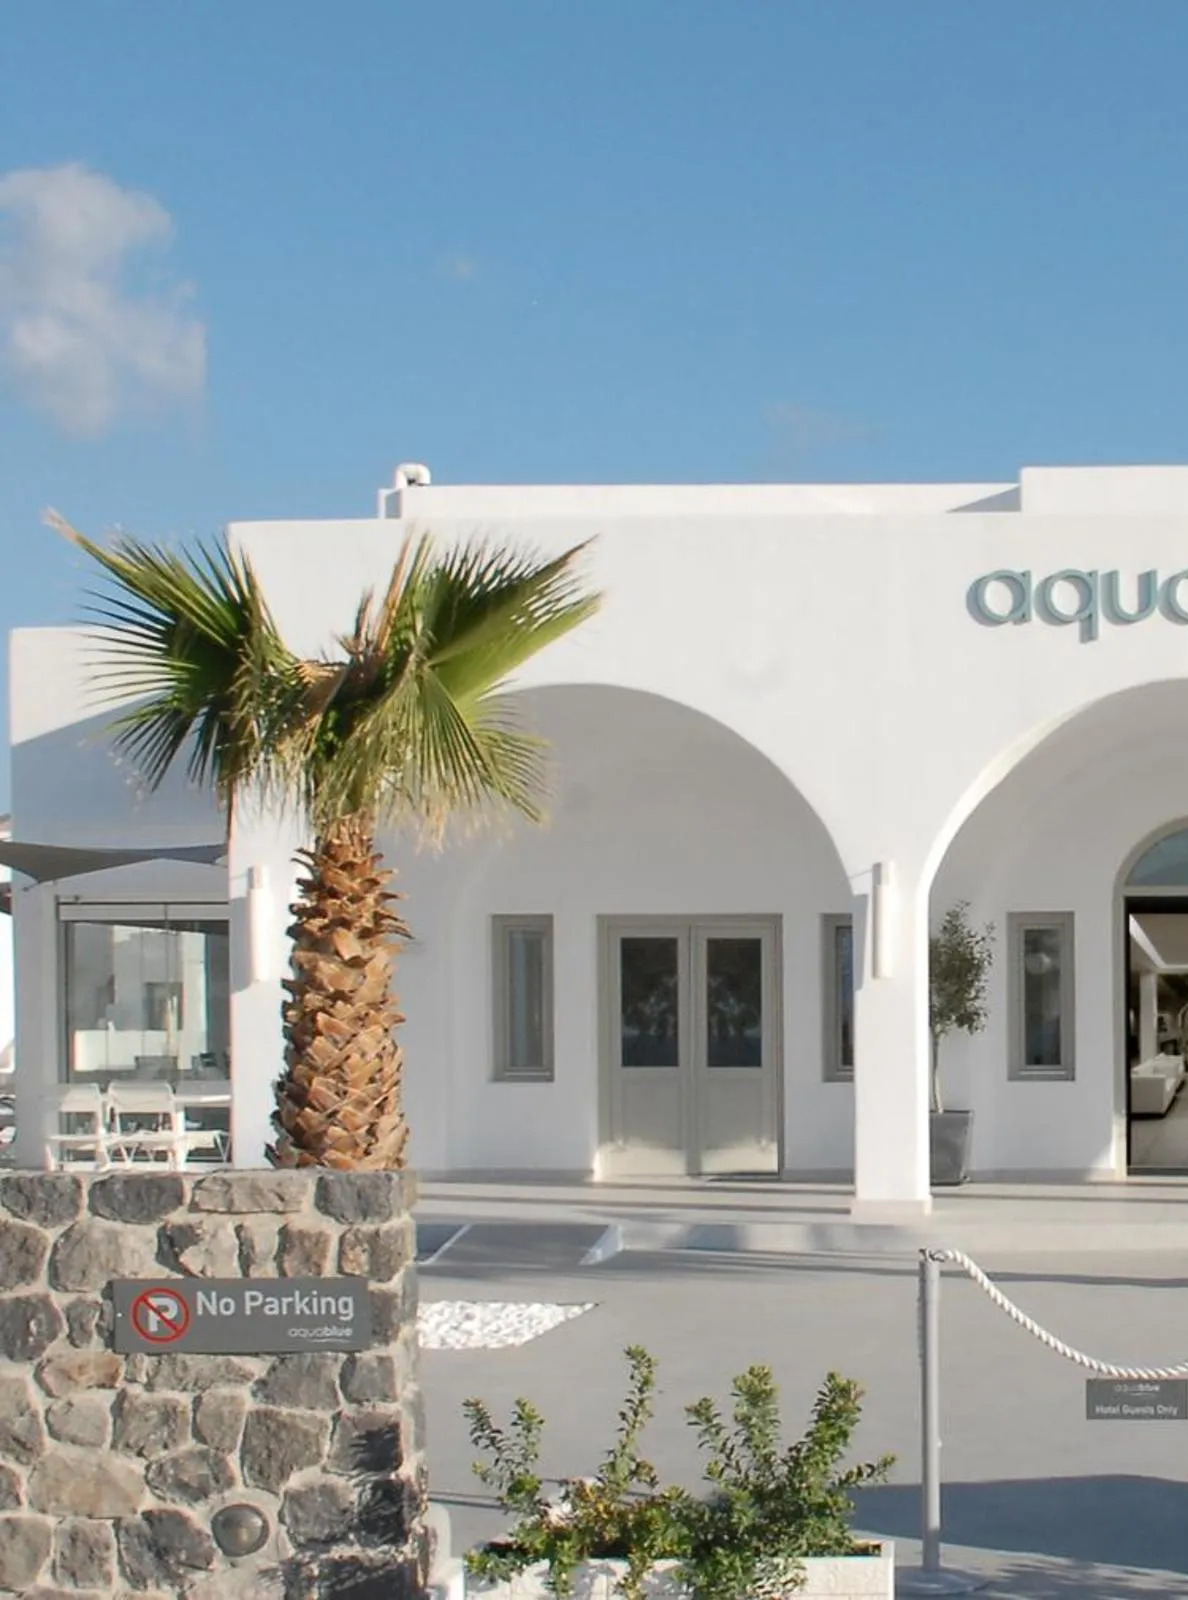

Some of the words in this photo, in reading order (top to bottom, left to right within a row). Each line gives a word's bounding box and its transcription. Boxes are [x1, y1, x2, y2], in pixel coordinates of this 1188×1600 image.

[196, 1291, 236, 1317] No
[244, 1290, 354, 1321] Parking
[288, 1324, 353, 1338] aquablue
[1156, 1404, 1179, 1417] Only
